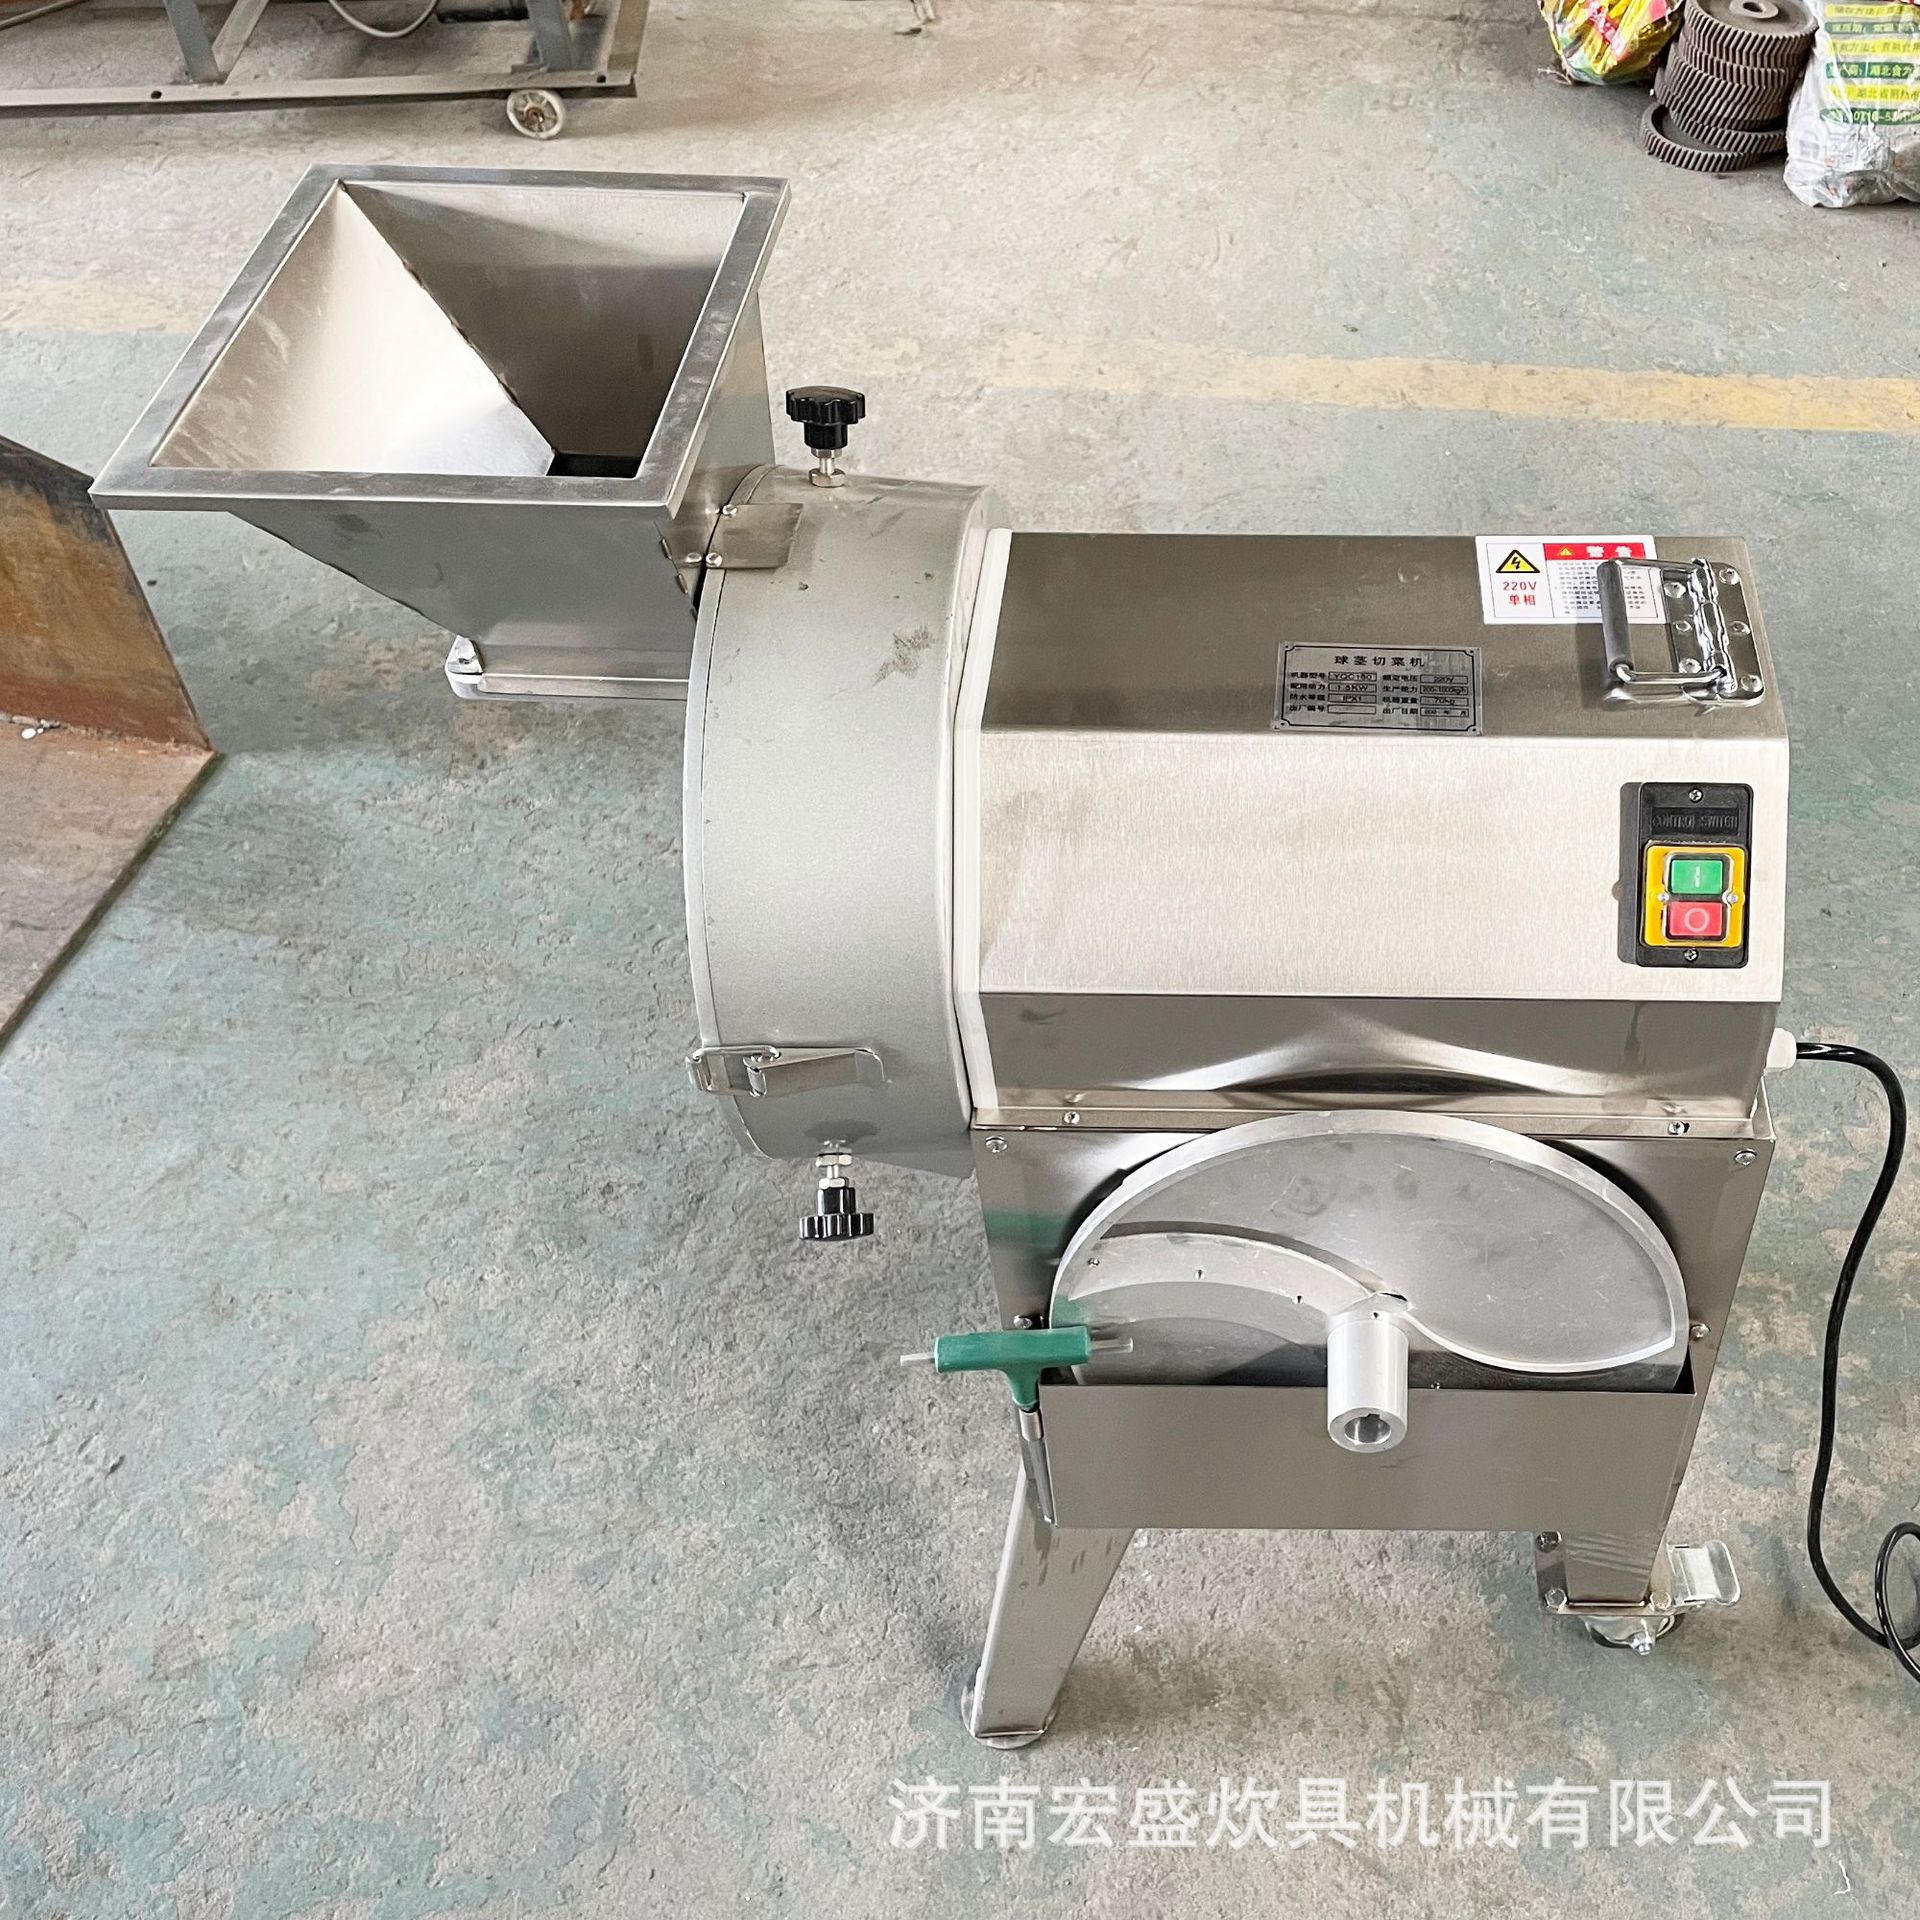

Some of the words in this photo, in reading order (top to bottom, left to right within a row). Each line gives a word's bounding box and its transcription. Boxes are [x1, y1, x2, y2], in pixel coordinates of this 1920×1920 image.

[1503, 581, 1538, 591] 220V
[1509, 594, 1536, 606] 单相
[1334, 655, 1425, 668] 球茎切菜机
